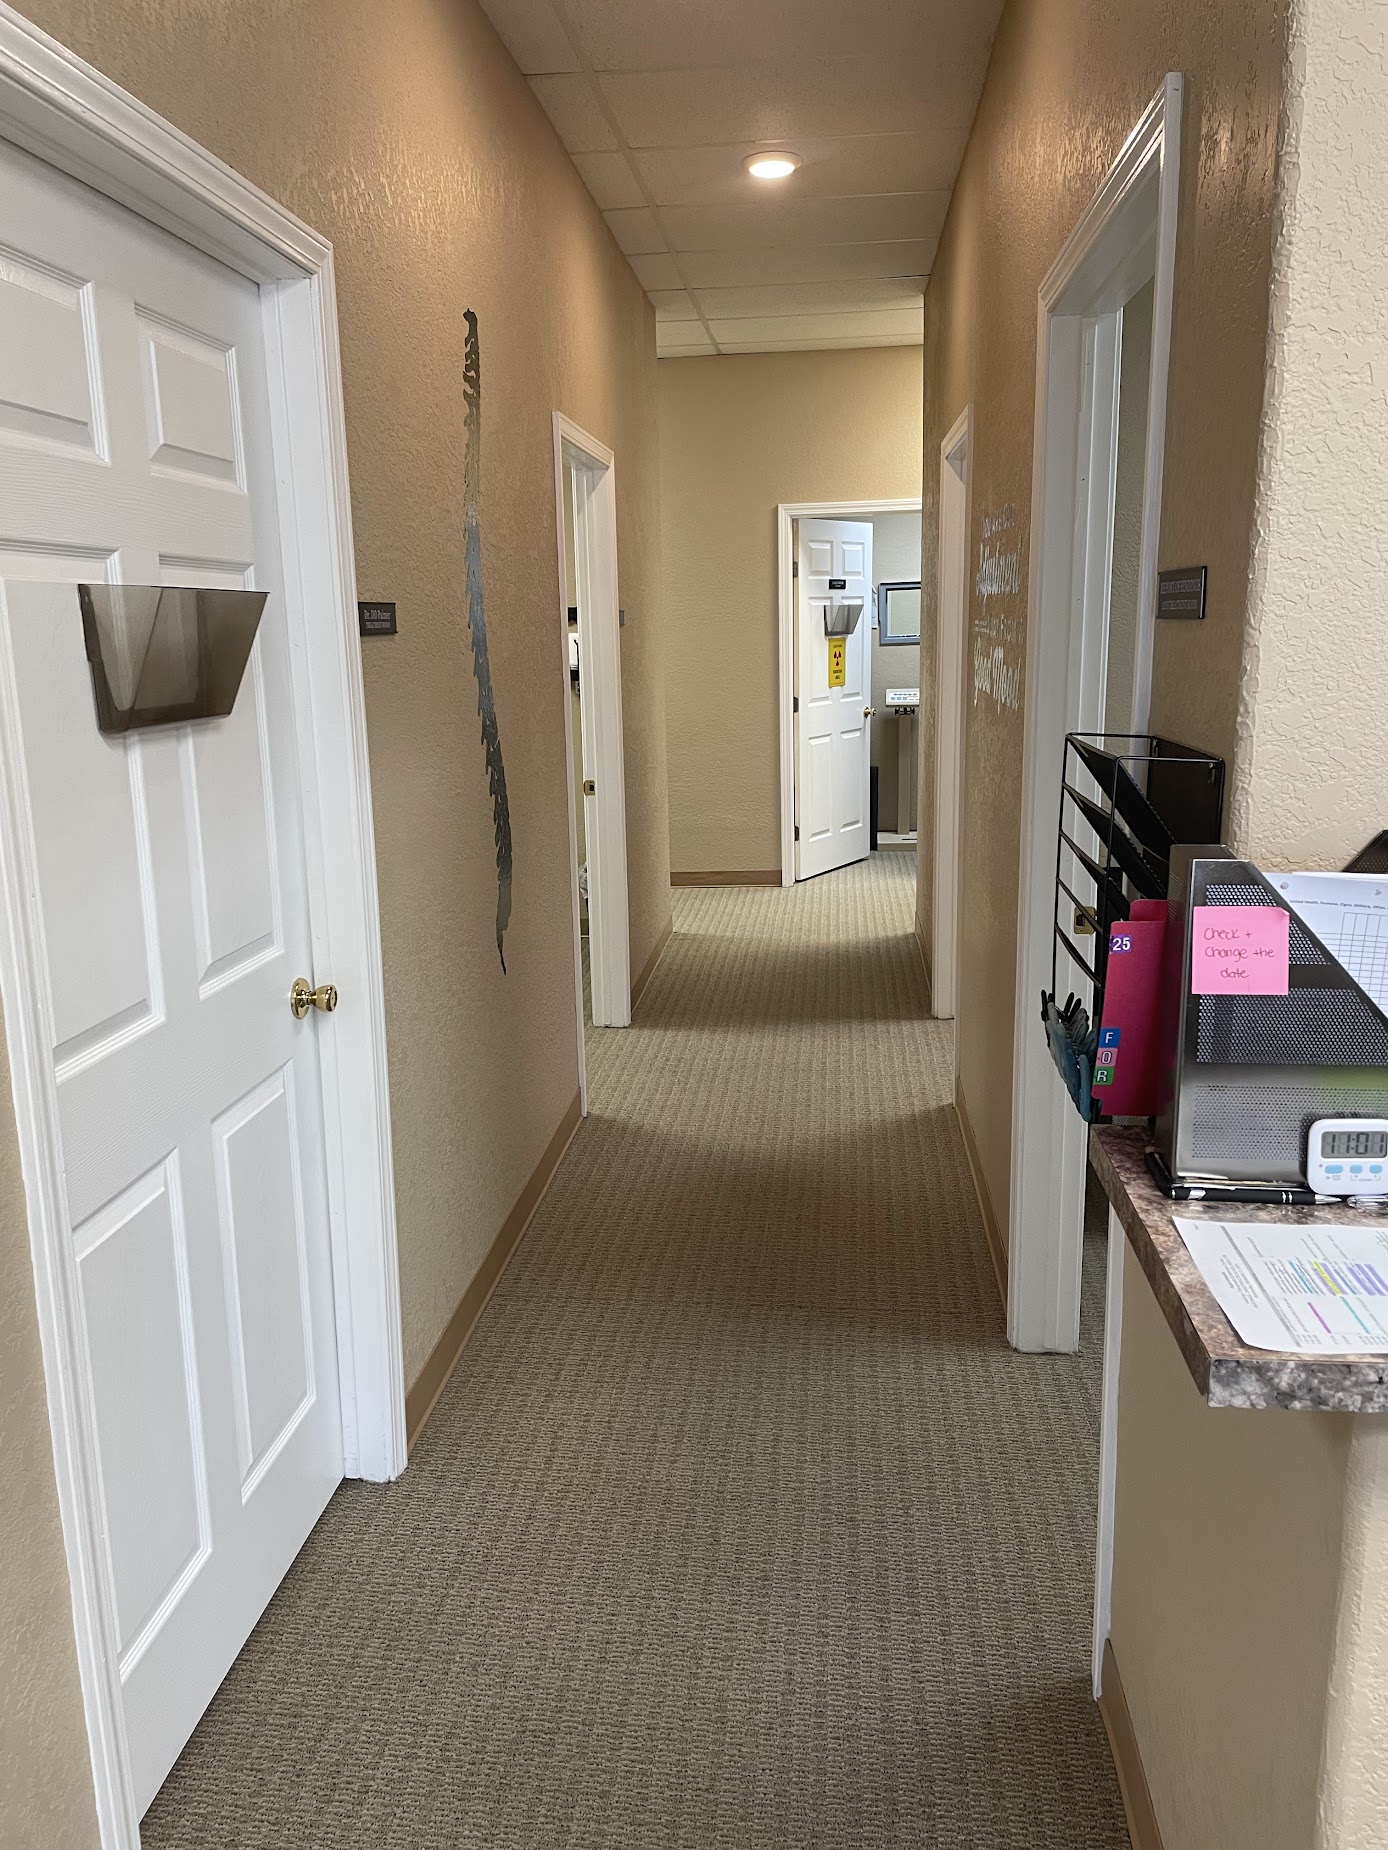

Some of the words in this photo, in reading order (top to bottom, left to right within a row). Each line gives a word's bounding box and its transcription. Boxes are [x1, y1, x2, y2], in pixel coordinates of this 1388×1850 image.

[974, 636, 993, 707] Good
[993, 645, 1022, 716] Mood
[1203, 927, 1240, 941] Check
[1112, 937, 1131, 952] 25
[1253, 947, 1275, 958] the
[1220, 967, 1250, 979] date
[1330, 1132, 1385, 1155] 11:01
